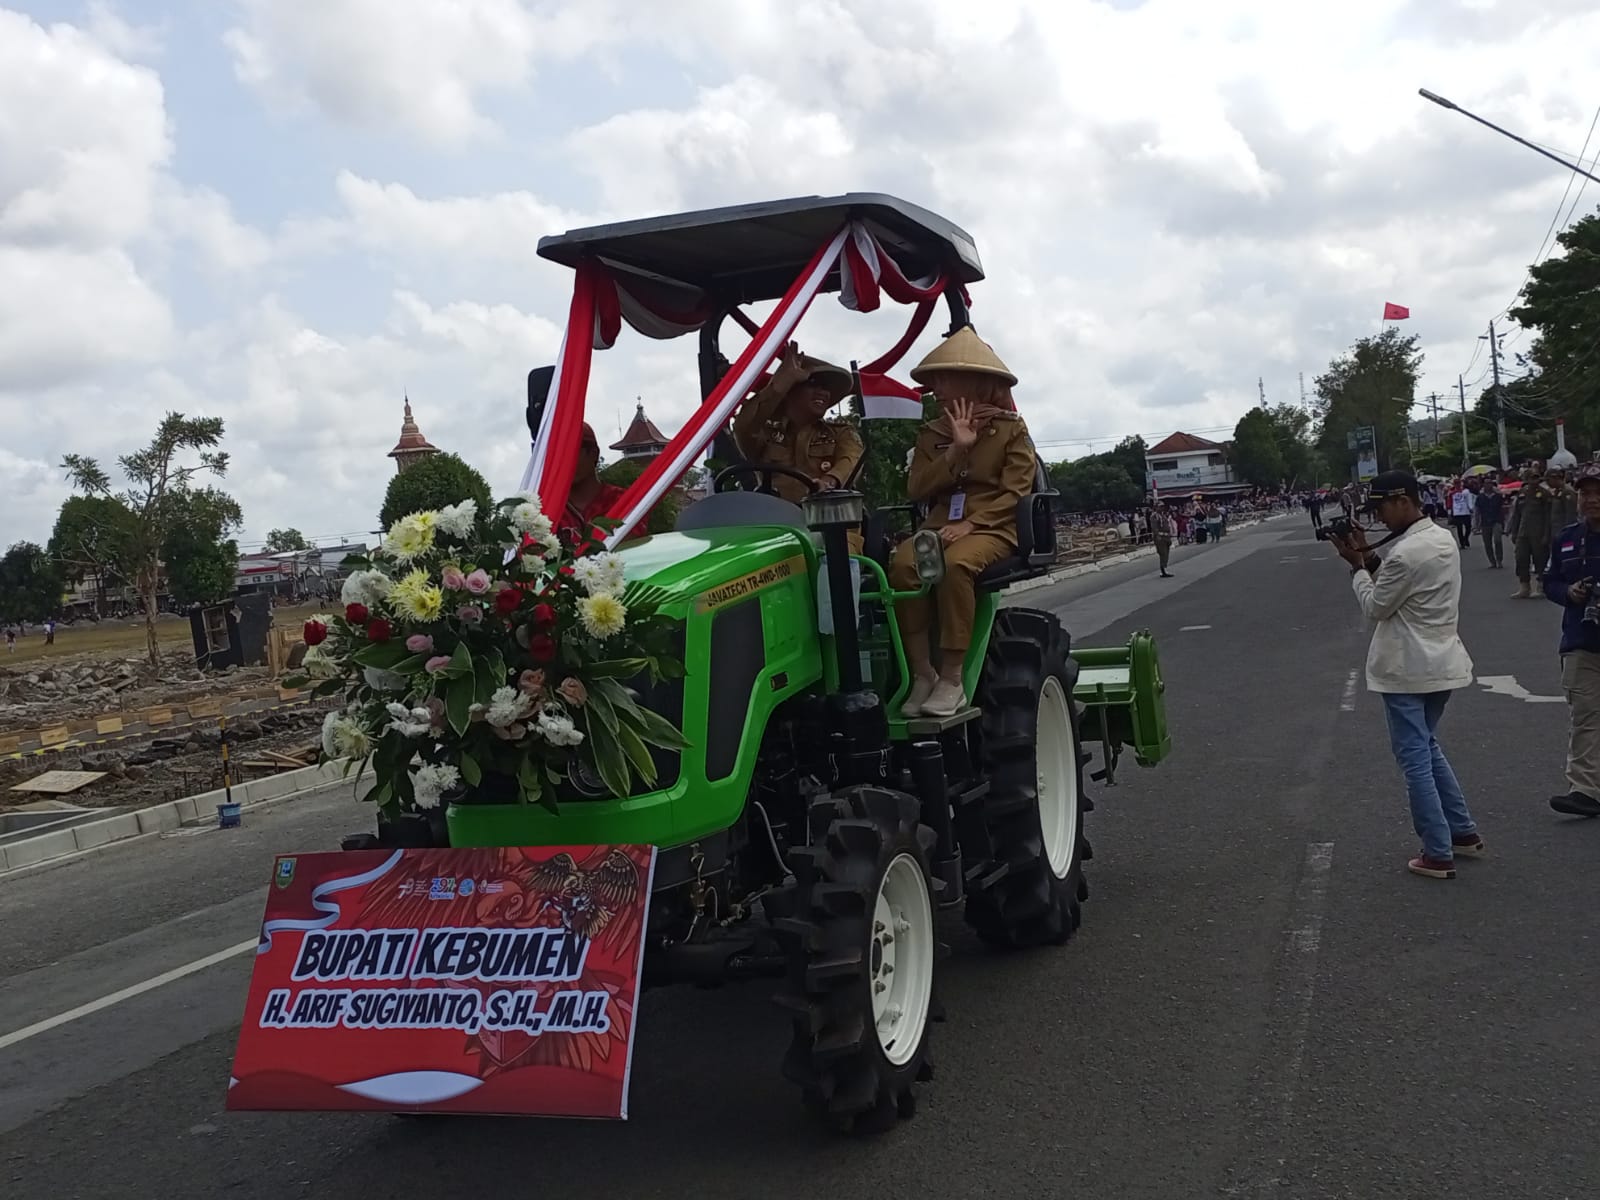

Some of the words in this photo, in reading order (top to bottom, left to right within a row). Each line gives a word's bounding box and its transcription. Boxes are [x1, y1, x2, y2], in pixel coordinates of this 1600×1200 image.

[706, 580, 748, 607] JAVATECH
[294, 932, 415, 978] BUPATI
[412, 931, 588, 978] KEBUMEN
[263, 993, 286, 1025] H.
[290, 993, 348, 1024] ARIF
[346, 992, 480, 1030] SUGIYANTO,
[487, 994, 542, 1031] S.H.,
[547, 995, 606, 1029] M.H.
